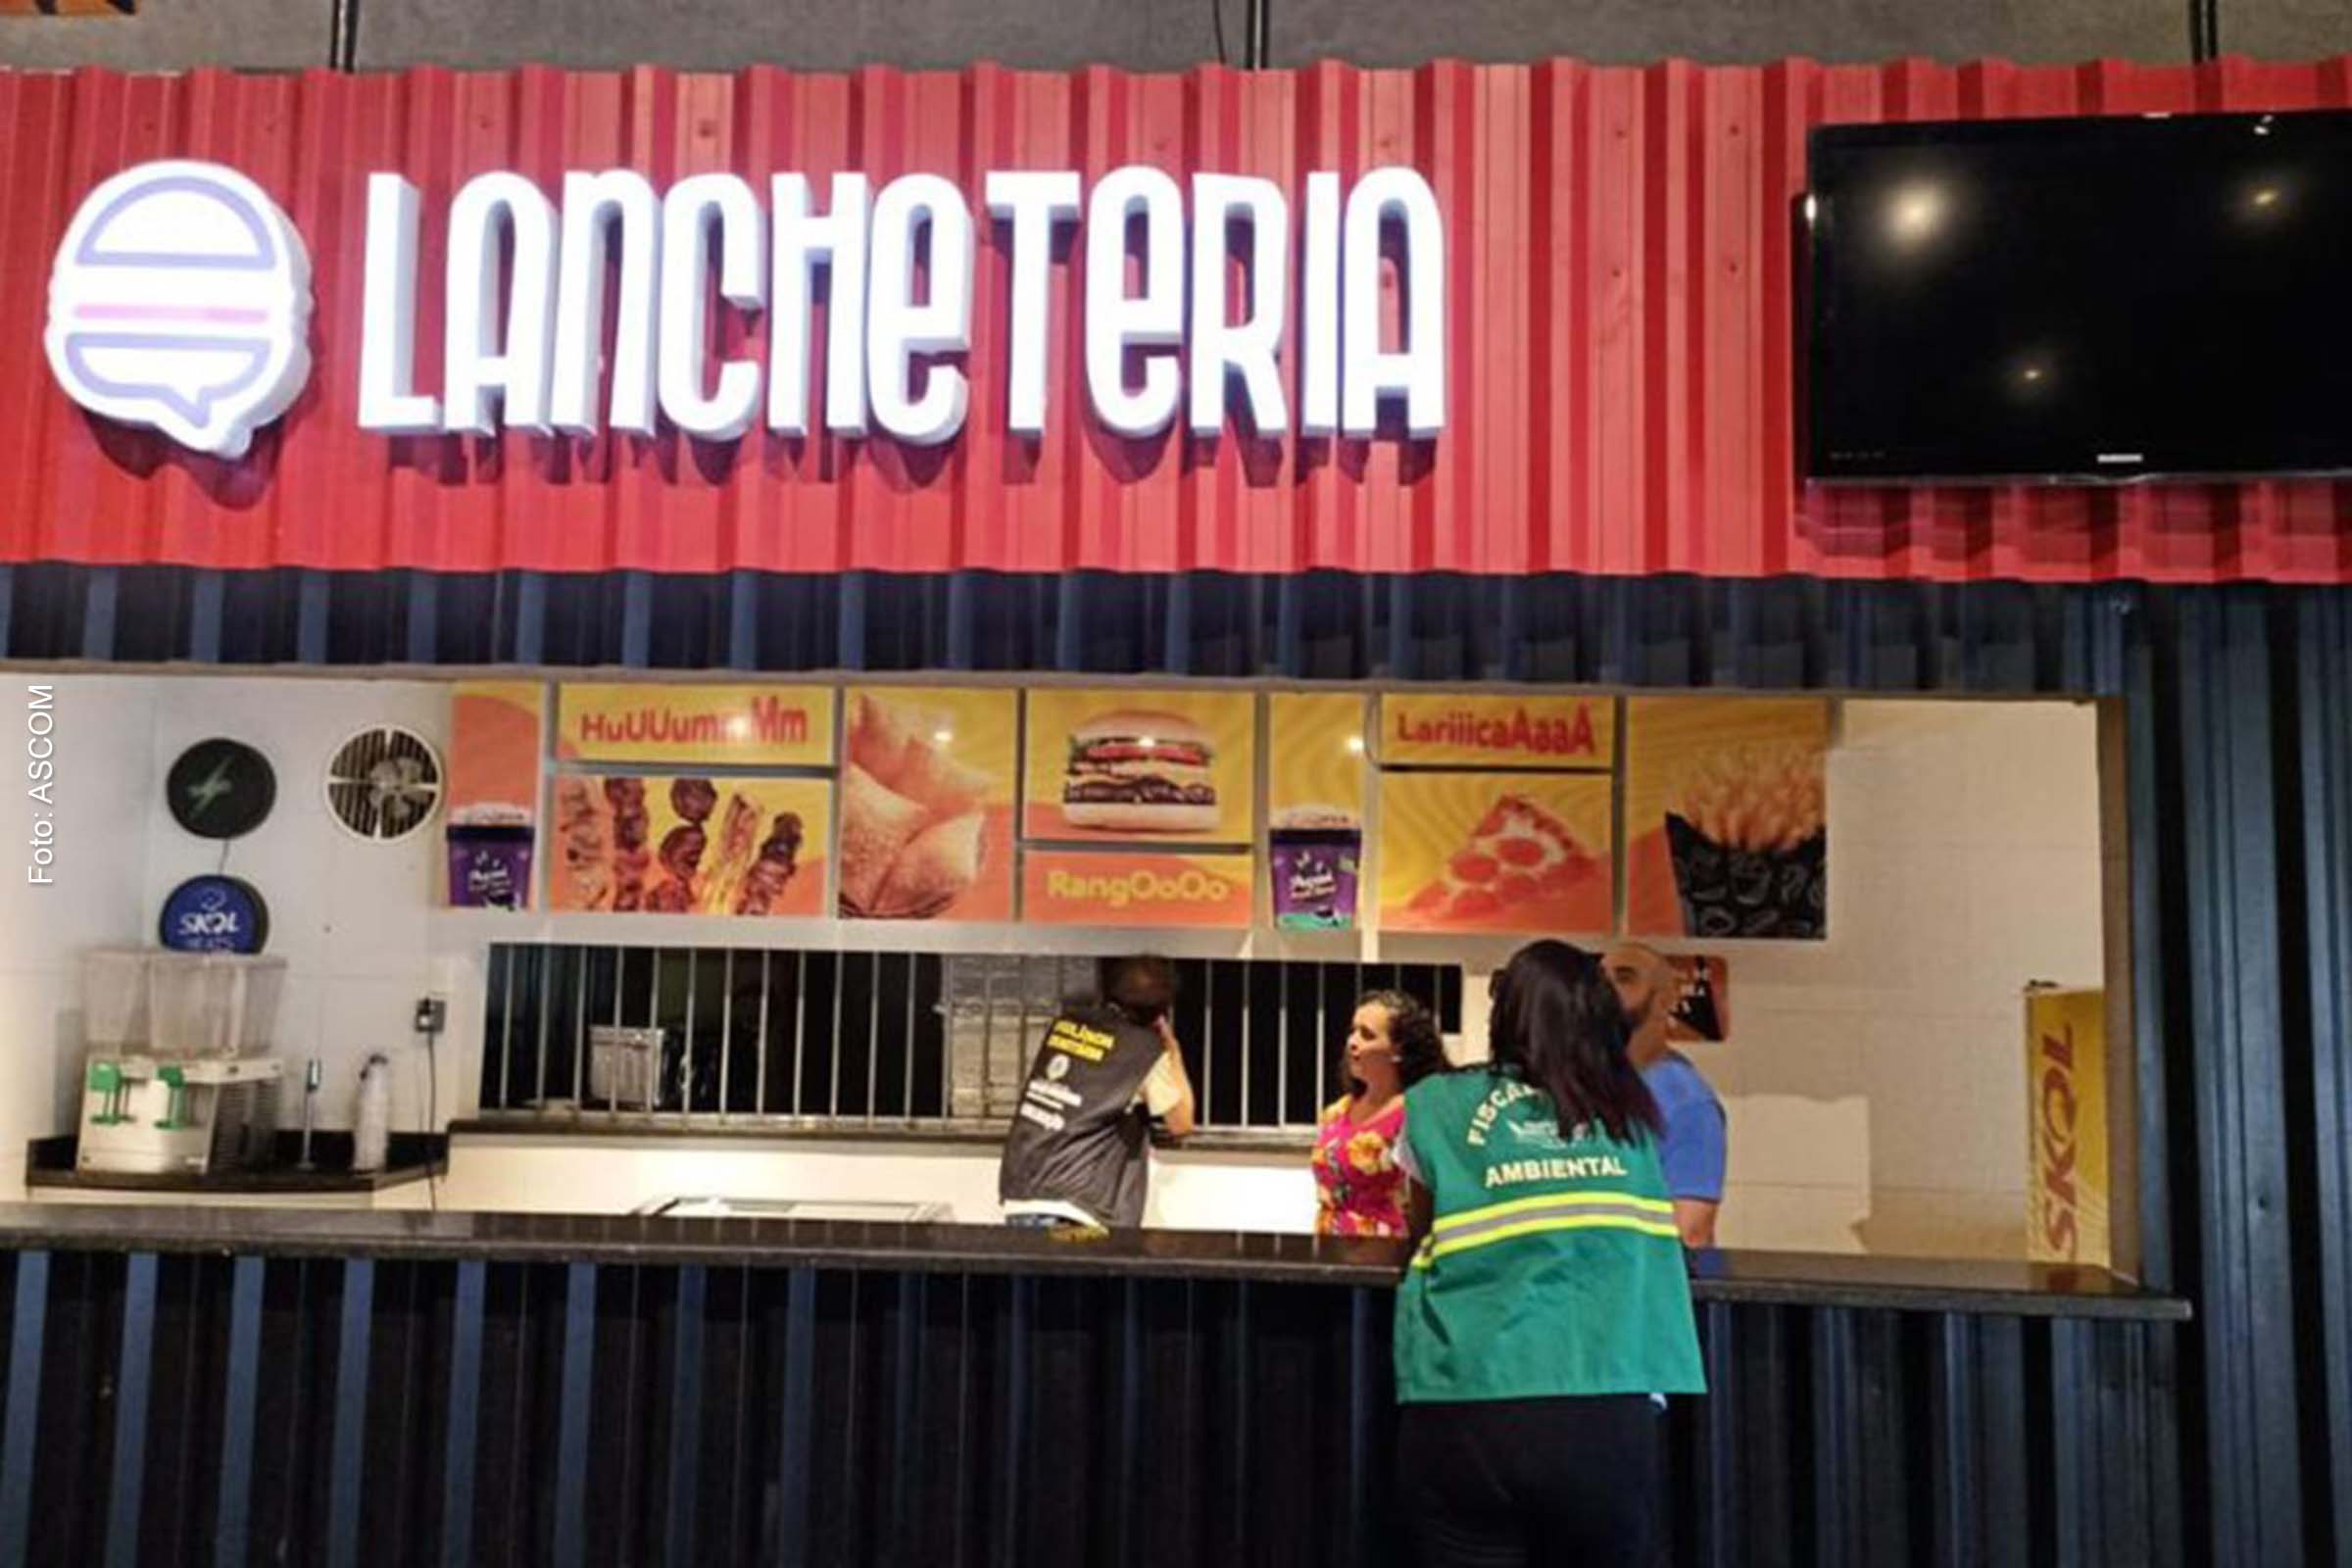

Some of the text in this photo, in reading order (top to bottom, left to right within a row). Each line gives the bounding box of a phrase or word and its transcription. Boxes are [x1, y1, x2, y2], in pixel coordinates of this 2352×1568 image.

[1047, 869, 1229, 906] RangOoOo
[178, 911, 239, 935] SKOL
[2041, 1022, 2077, 1263] SKOL
[1485, 1155, 1628, 1188] AMBIENTAL
